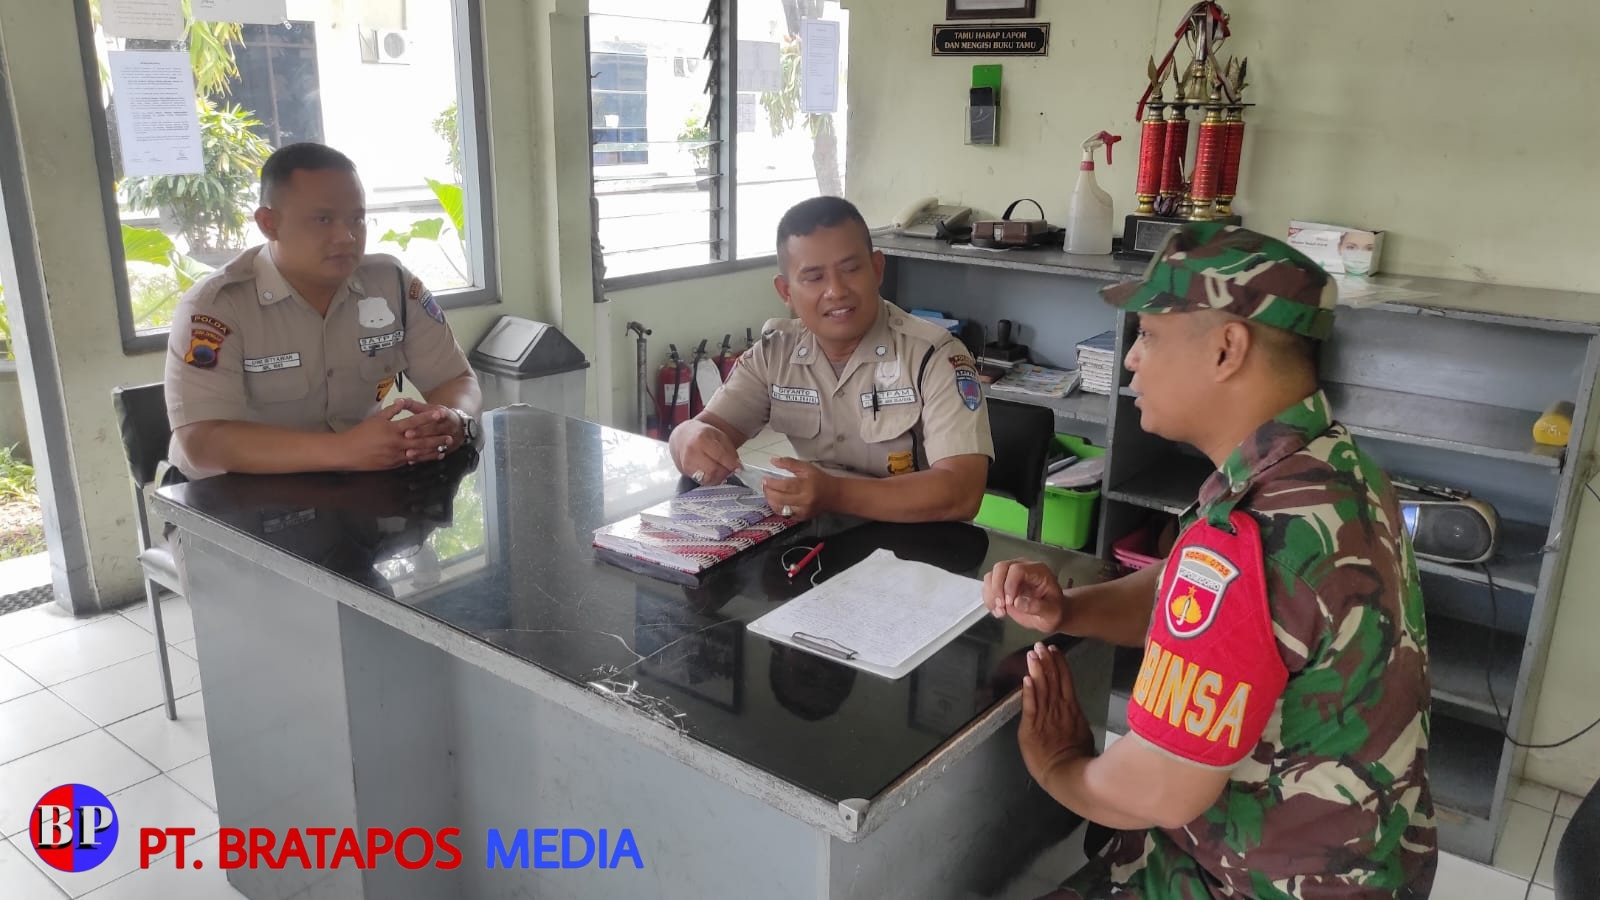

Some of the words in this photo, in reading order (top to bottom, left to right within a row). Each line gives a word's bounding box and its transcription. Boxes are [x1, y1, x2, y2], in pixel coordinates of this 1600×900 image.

[954, 31, 974, 39] TAMU
[975, 31, 1000, 39] HARAP
[1002, 31, 1027, 39] LAPOR
[944, 41, 960, 49] DAN
[961, 41, 992, 49] MENGISI
[993, 41, 1014, 49] BUKU
[1016, 41, 1036, 49] TAMU
[194, 315, 228, 334] POLDA
[864, 389, 911, 399] STPAM
